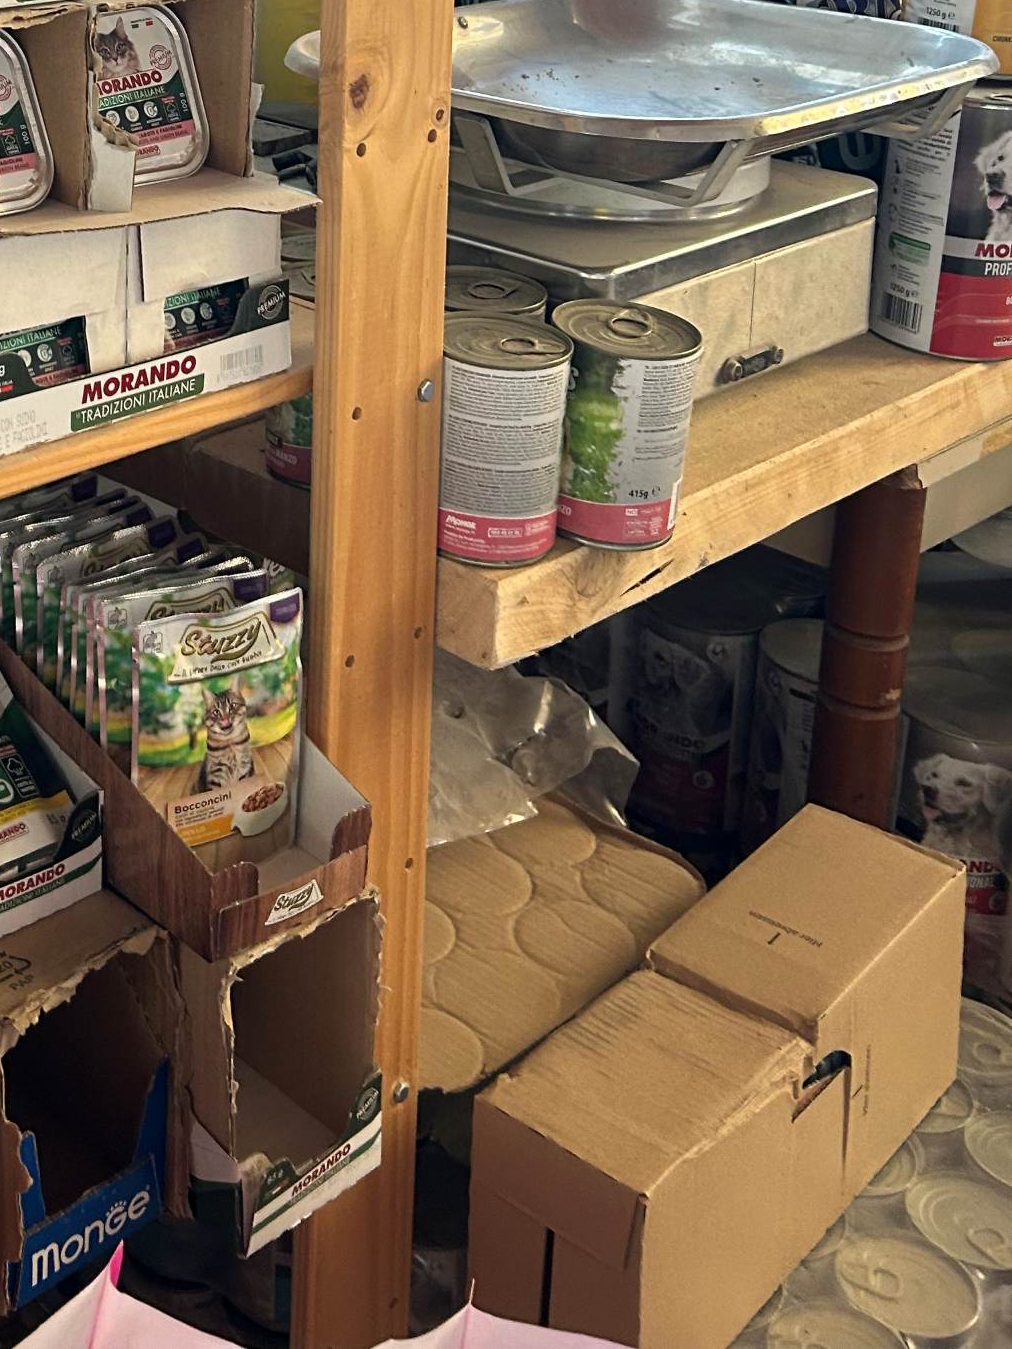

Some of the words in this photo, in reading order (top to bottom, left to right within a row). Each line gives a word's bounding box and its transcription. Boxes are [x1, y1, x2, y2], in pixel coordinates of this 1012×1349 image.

[99, 95, 132, 108] ADIZIONI
[257, 290, 286, 314] PREMIUM
[81, 354, 198, 404] MORANDO
[80, 392, 146, 424] TRADIZIONI
[148, 379, 197, 405] ITALIANE
[628, 489, 649, 500] 415g
[181, 620, 262, 664] Stuzzy
[175, 790, 232, 814] Bocconcini
[292, 1143, 351, 1197] MORANDO
